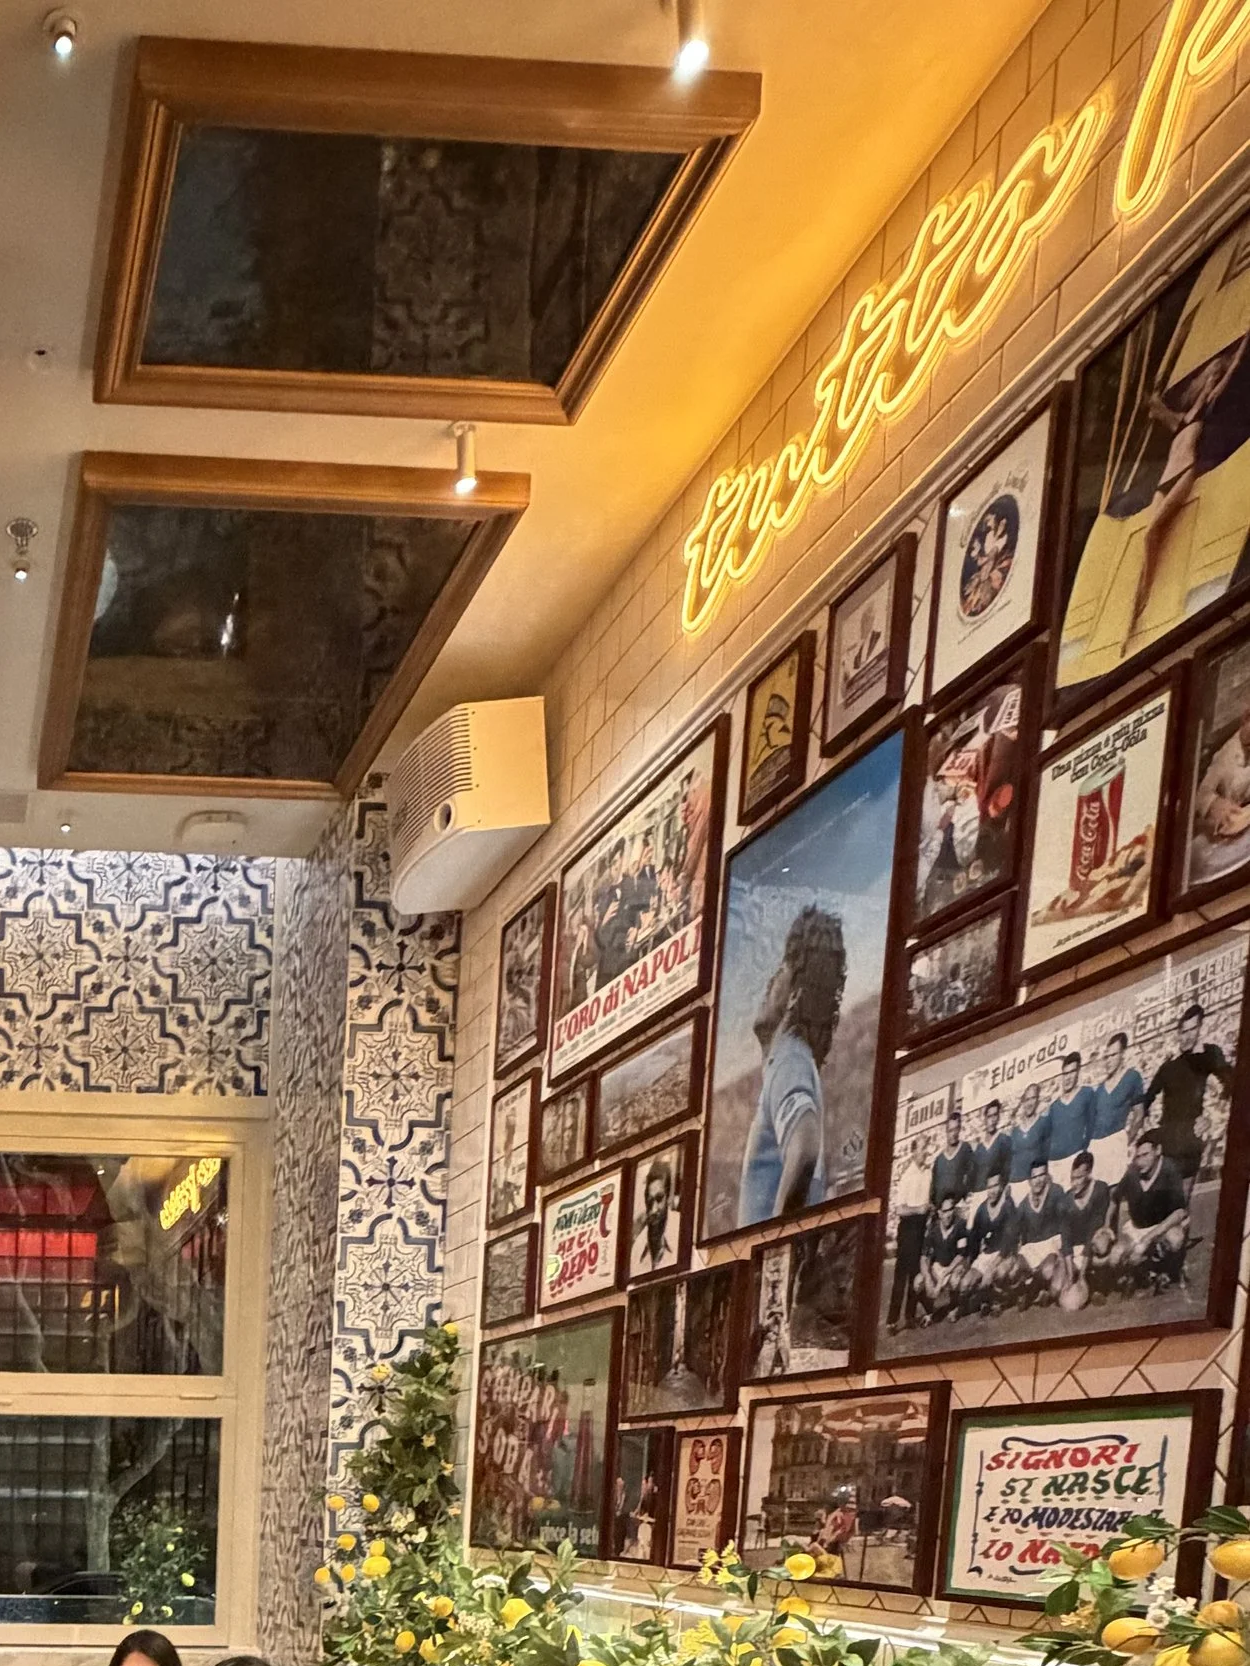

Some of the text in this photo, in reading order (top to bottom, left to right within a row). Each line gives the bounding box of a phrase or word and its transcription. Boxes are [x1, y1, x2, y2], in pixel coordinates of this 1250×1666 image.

[1091, 727, 1148, 771] Coca-Cola
[554, 995, 602, 1052] L'ORO
[602, 980, 622, 1018] di
[621, 923, 702, 1005] NAPOLI
[990, 1034, 1069, 1090] Eldorado
[985, 1443, 1141, 1472] SIGNORI
[1041, 1462, 1161, 1496] NASCE
[983, 1506, 1000, 1522] E
